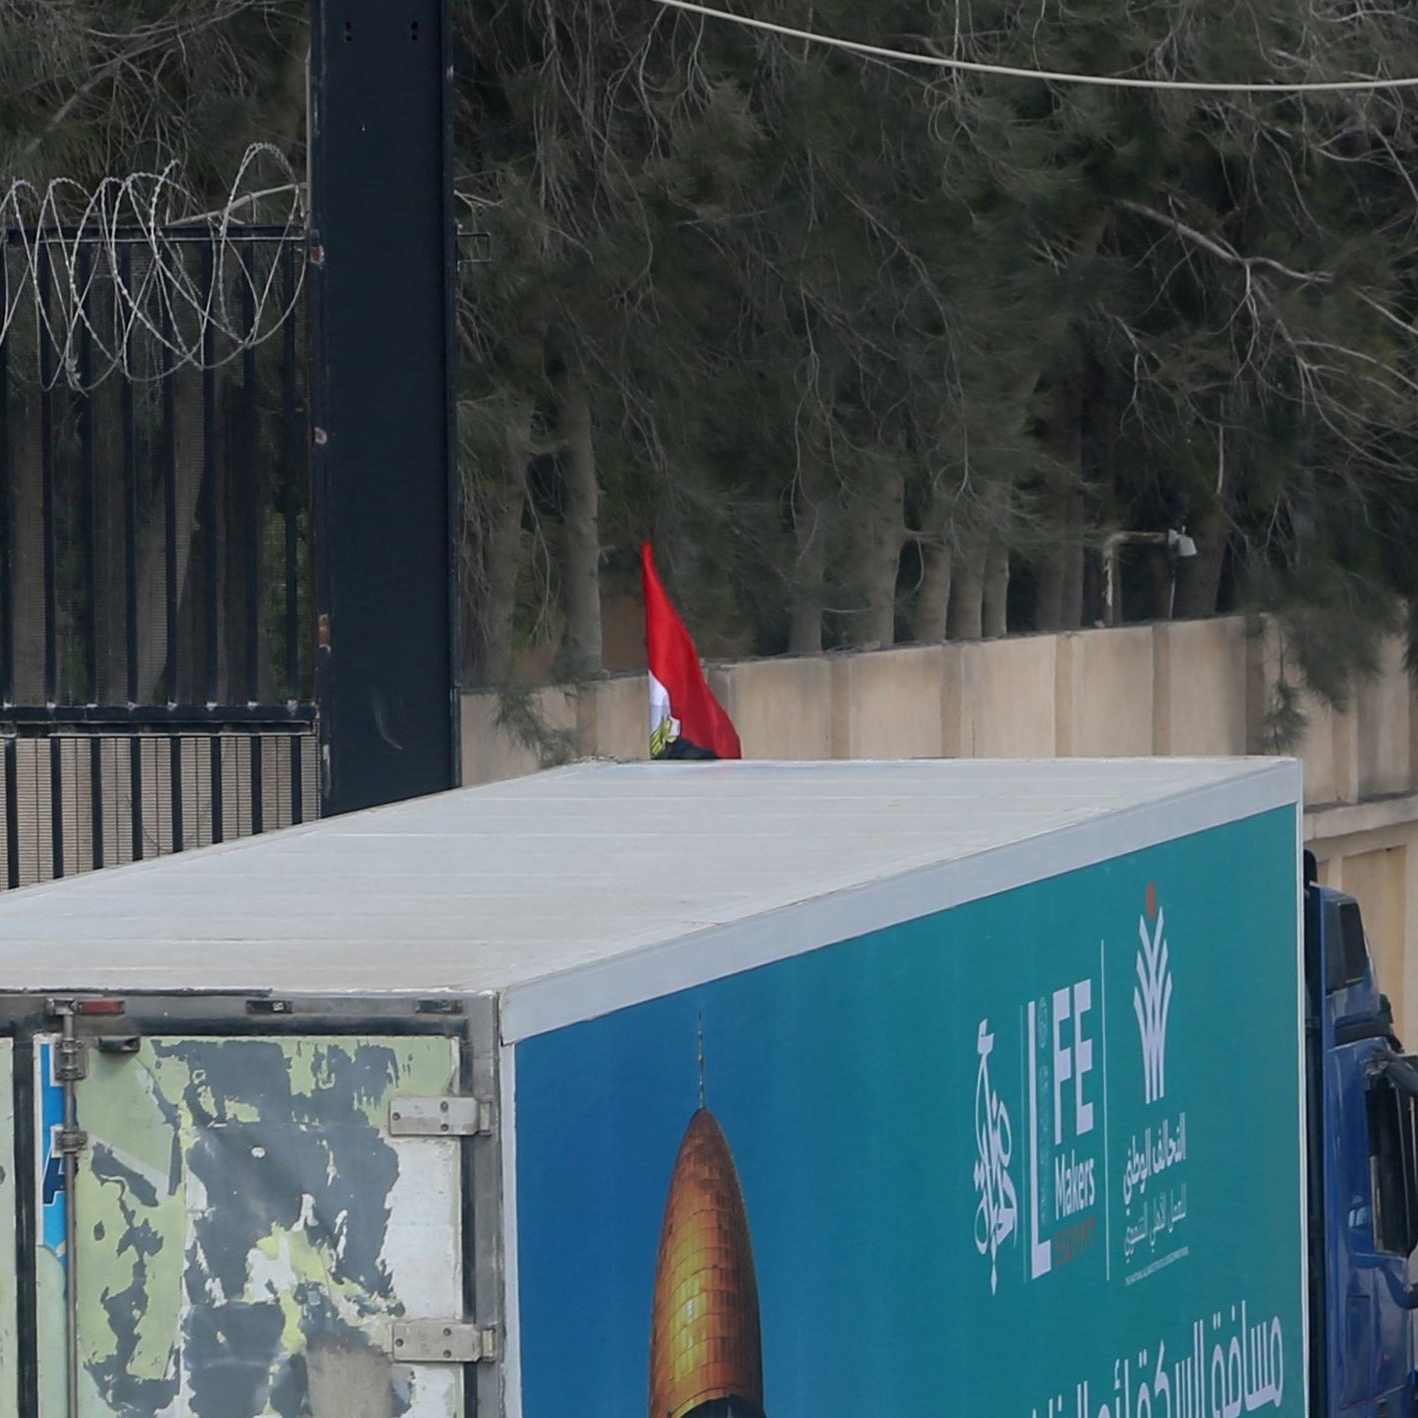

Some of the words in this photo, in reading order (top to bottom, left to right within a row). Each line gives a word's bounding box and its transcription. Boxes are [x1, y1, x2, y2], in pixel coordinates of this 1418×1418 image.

[1123, 1128, 1152, 1216] الوطني
[1152, 1112, 1186, 1174] التحالف
[1055, 1149, 1095, 1221] Makers
